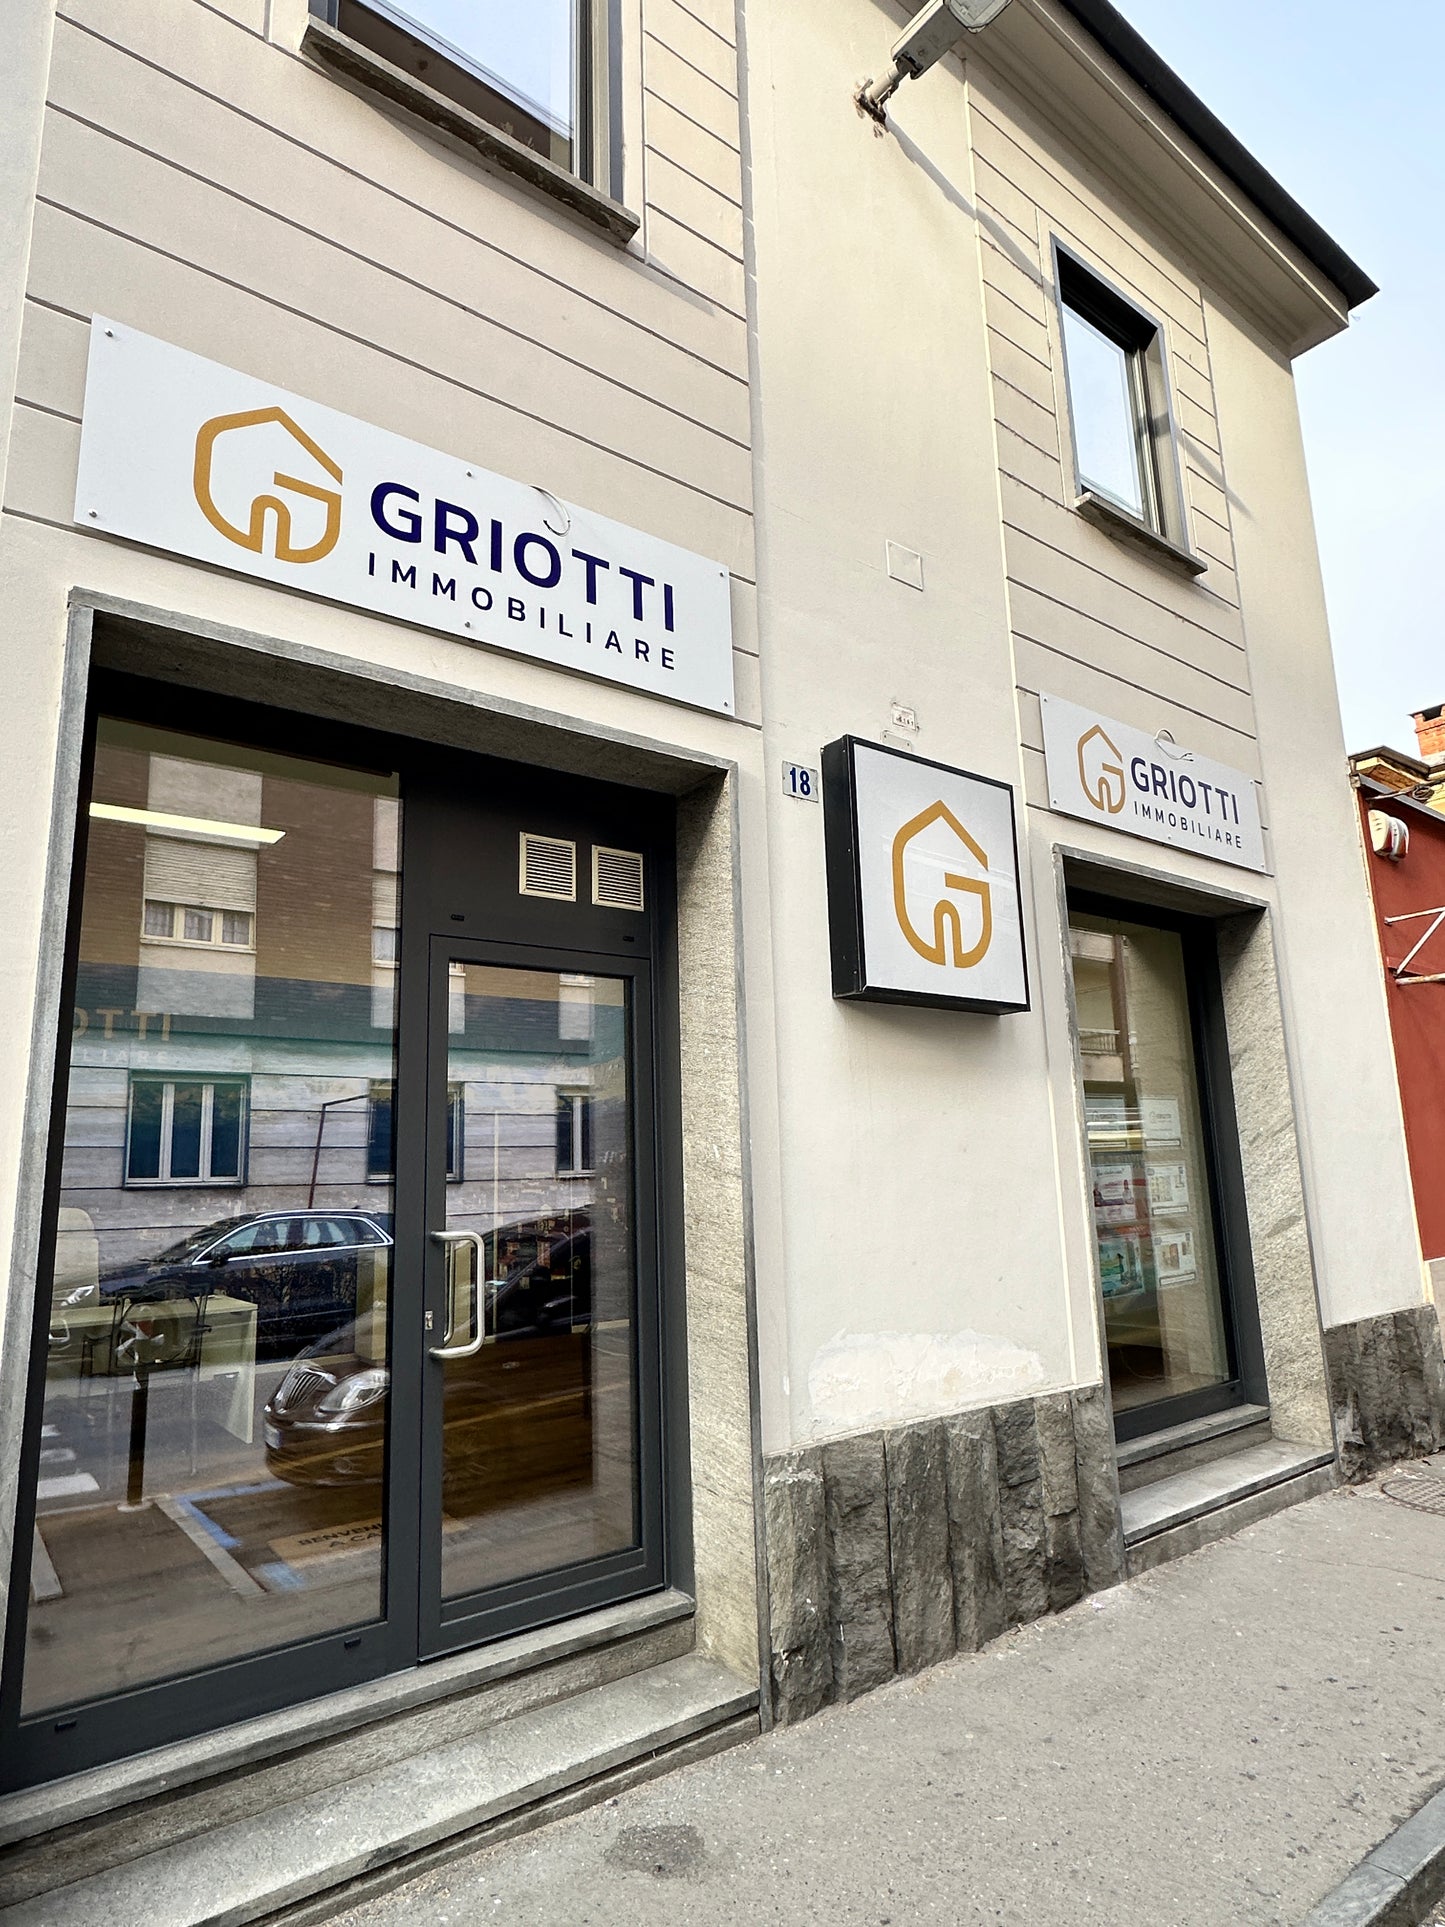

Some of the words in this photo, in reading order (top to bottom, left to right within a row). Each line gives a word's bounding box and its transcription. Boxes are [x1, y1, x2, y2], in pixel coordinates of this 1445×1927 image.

[371, 481, 675, 633] GRIOTTI
[369, 552, 676, 672] IMMOBILIARE
[789, 766, 811, 796] 18
[1130, 757, 1240, 825] GRIOTTI
[1134, 800, 1243, 849] IMMOBILIARE
